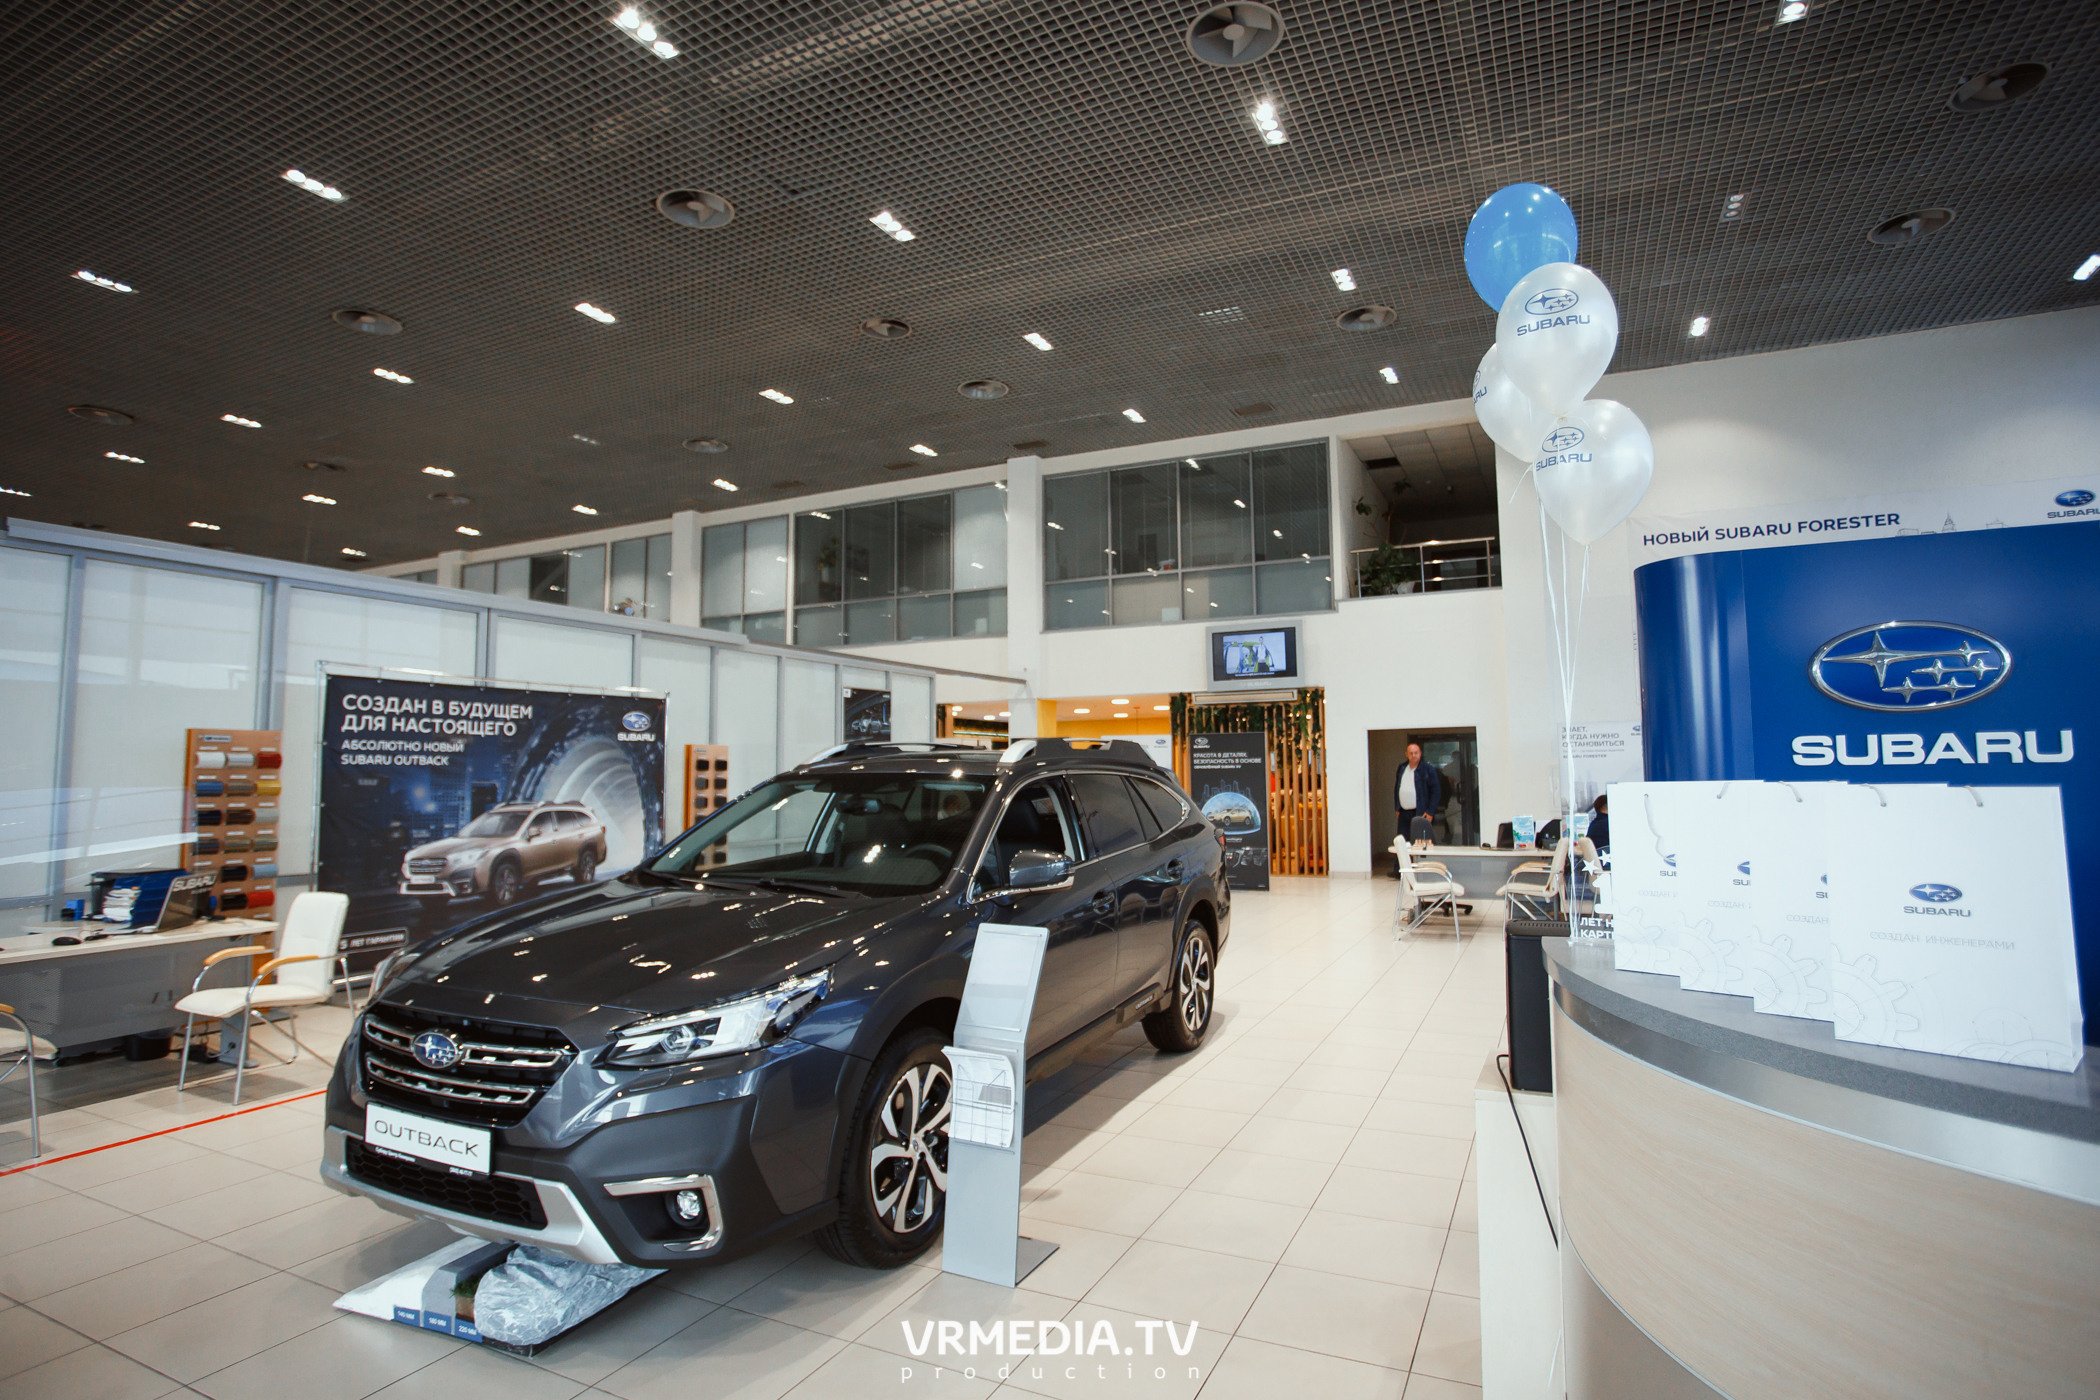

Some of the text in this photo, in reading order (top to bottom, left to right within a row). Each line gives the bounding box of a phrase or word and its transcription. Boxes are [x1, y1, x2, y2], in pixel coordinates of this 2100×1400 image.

[1517, 314, 1590, 336] SUBARU
[1536, 453, 1592, 471] SUBARU
[1643, 513, 1900, 546] НОВЫЙ SUBARU FORESTER
[341, 693, 534, 721] СОЗДАН В БУДУЩЕМ
[340, 713, 518, 738] ДЛЯ НАСТОЯЩЕГО
[341, 739, 466, 753] АБСОЛЮТНО НОВЫЙ
[617, 732, 656, 742] SUBARU
[1791, 729, 2075, 767] SUBARU
[340, 753, 450, 766] SUBARU OUTBACK
[1732, 878, 1751, 886] SU
[1903, 905, 1972, 918] SUBARU
[1580, 917, 1614, 928] ЛЕТ Н
[1580, 929, 1614, 939] КАРТ
[1870, 931, 2015, 950] СОЗДАН ИНЖЕНЕРАМИ
[374, 1118, 478, 1158] OUTBACK
